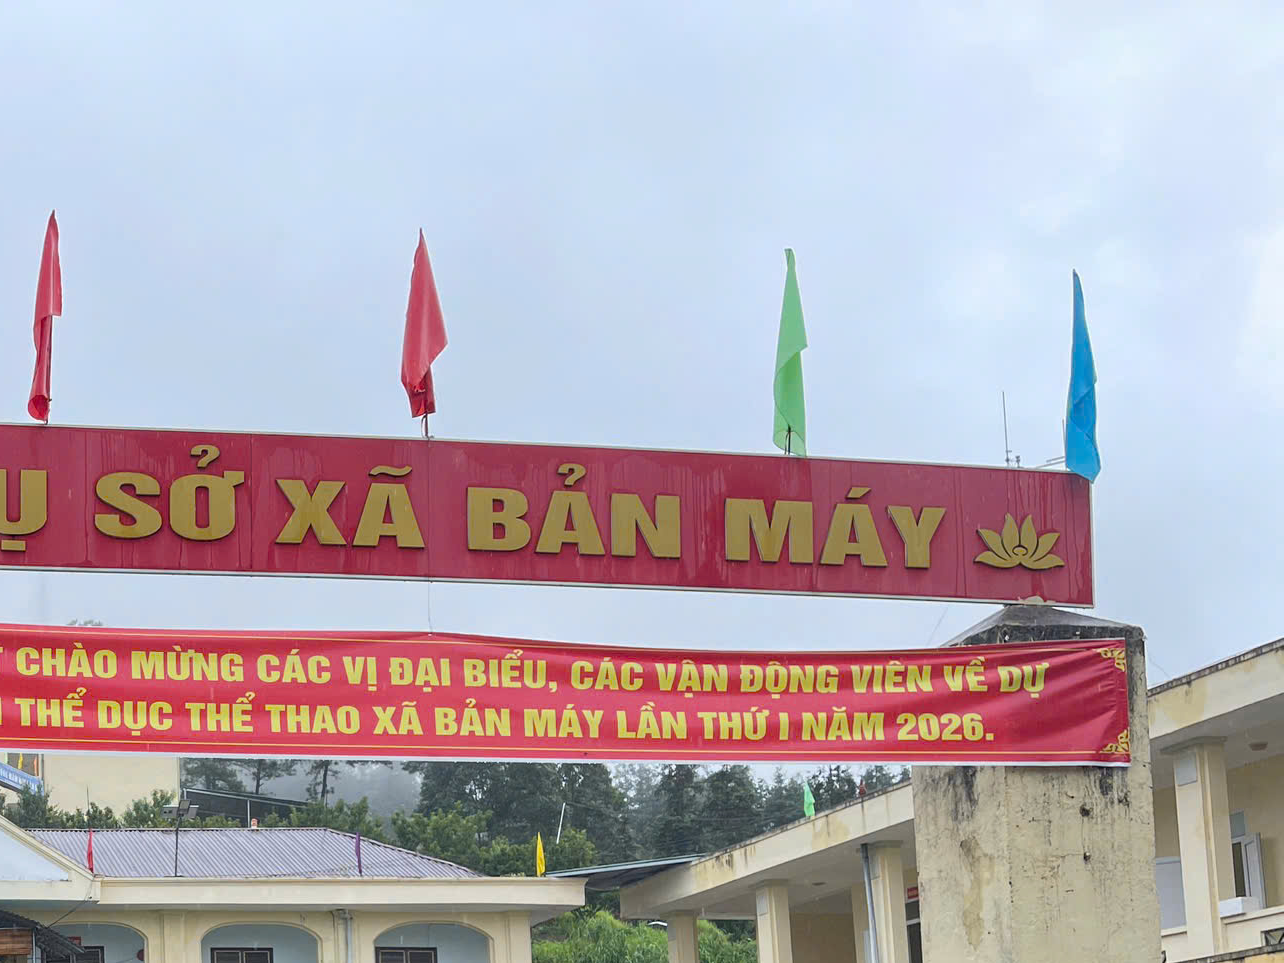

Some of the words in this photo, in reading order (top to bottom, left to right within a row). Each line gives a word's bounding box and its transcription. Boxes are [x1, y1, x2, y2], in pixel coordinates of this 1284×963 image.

[95, 445, 246, 542] SỞ
[275, 465, 424, 548] XÃ
[467, 463, 682, 558] BẢN
[726, 487, 946, 569] MÁY
[15, 642, 118, 680] CHÀO
[131, 645, 244, 683] MỪNG
[256, 648, 333, 684] CÁC
[342, 656, 378, 693] VỊ
[387, 657, 452, 696] ĐẠI
[463, 649, 559, 693] BIỂU,
[571, 656, 645, 692] CÁC
[654, 658, 730, 701] VẬN
[738, 658, 840, 700] ĐỘNG
[851, 660, 934, 695] VIÊN
[942, 656, 990, 694] VỀ
[997, 662, 1050, 700] DỰ
[14, 687, 86, 729] THỂ
[97, 700, 174, 737] DỤC
[184, 689, 257, 733] THỂ
[264, 704, 362, 736] THAO
[372, 700, 424, 737] XÃ
[435, 698, 513, 738] BẢN
[523, 702, 606, 740] MÁY
[616, 700, 689, 741] LẦN
[697, 706, 771, 742] THỨ
[779, 711, 791, 742] I
[801, 706, 886, 742] NĂM
[896, 712, 995, 743] 2026.
